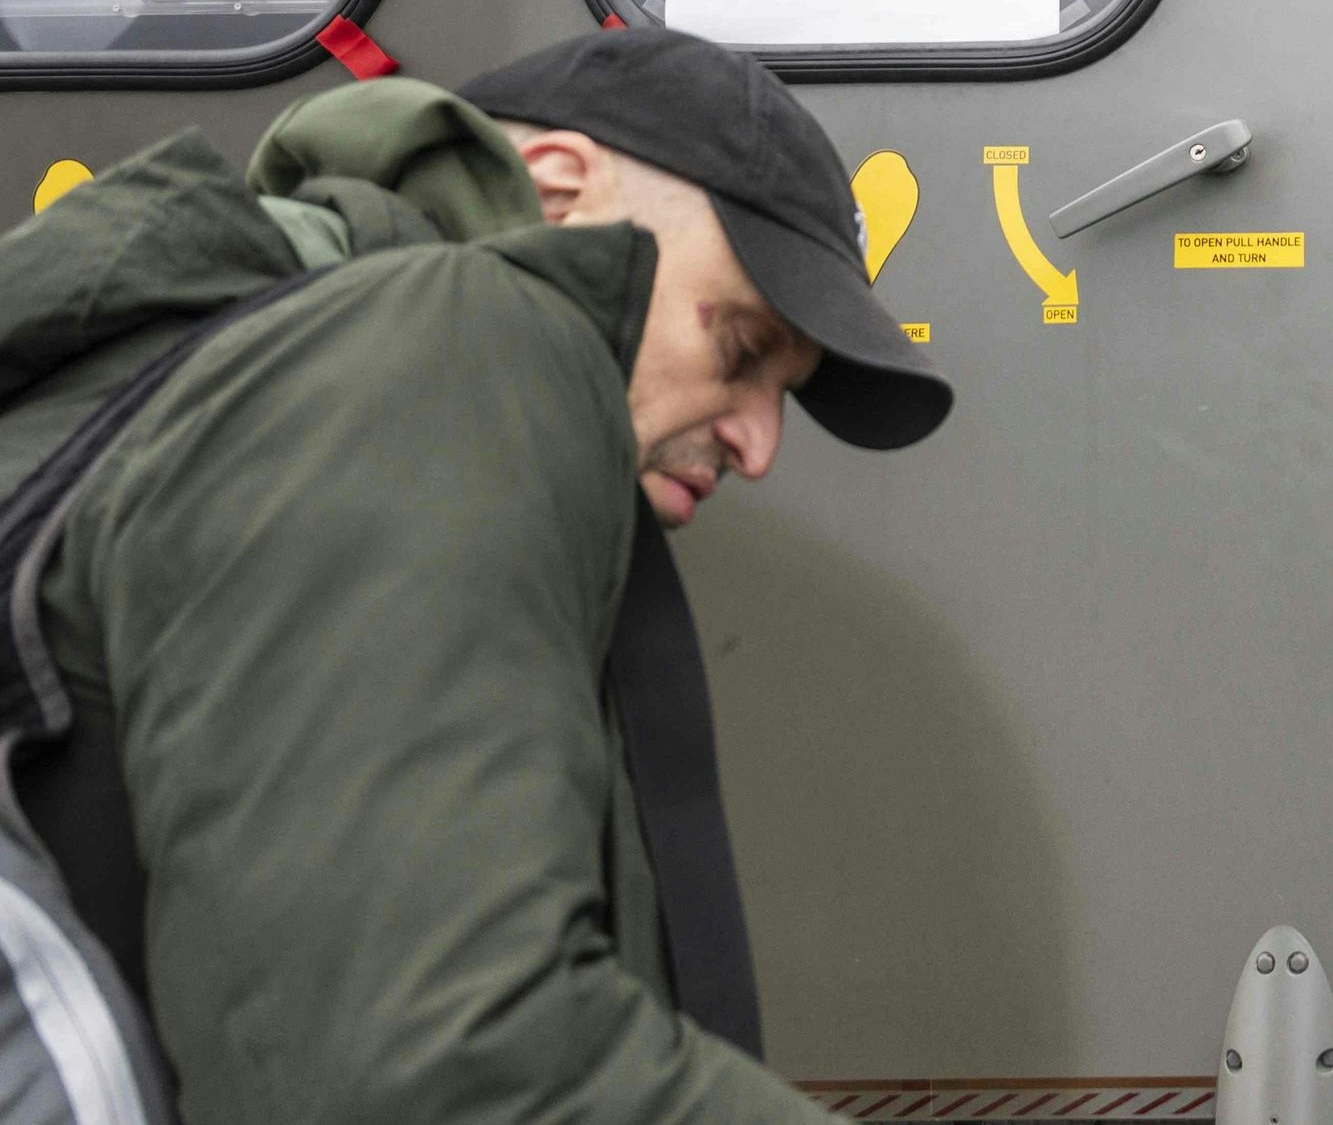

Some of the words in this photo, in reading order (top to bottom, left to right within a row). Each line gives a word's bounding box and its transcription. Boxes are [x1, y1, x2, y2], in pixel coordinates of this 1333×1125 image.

[985, 150, 1027, 160] CLOSED
[1178, 237, 1191, 248] TO
[1193, 237, 1223, 247] OPEN
[1226, 237, 1253, 247] PULL
[1256, 236, 1301, 247] HANDLE
[1212, 253, 1235, 263] AND
[1238, 253, 1267, 263] TURN
[1045, 309, 1075, 320] OPEN
[904, 328, 926, 338] ERE
